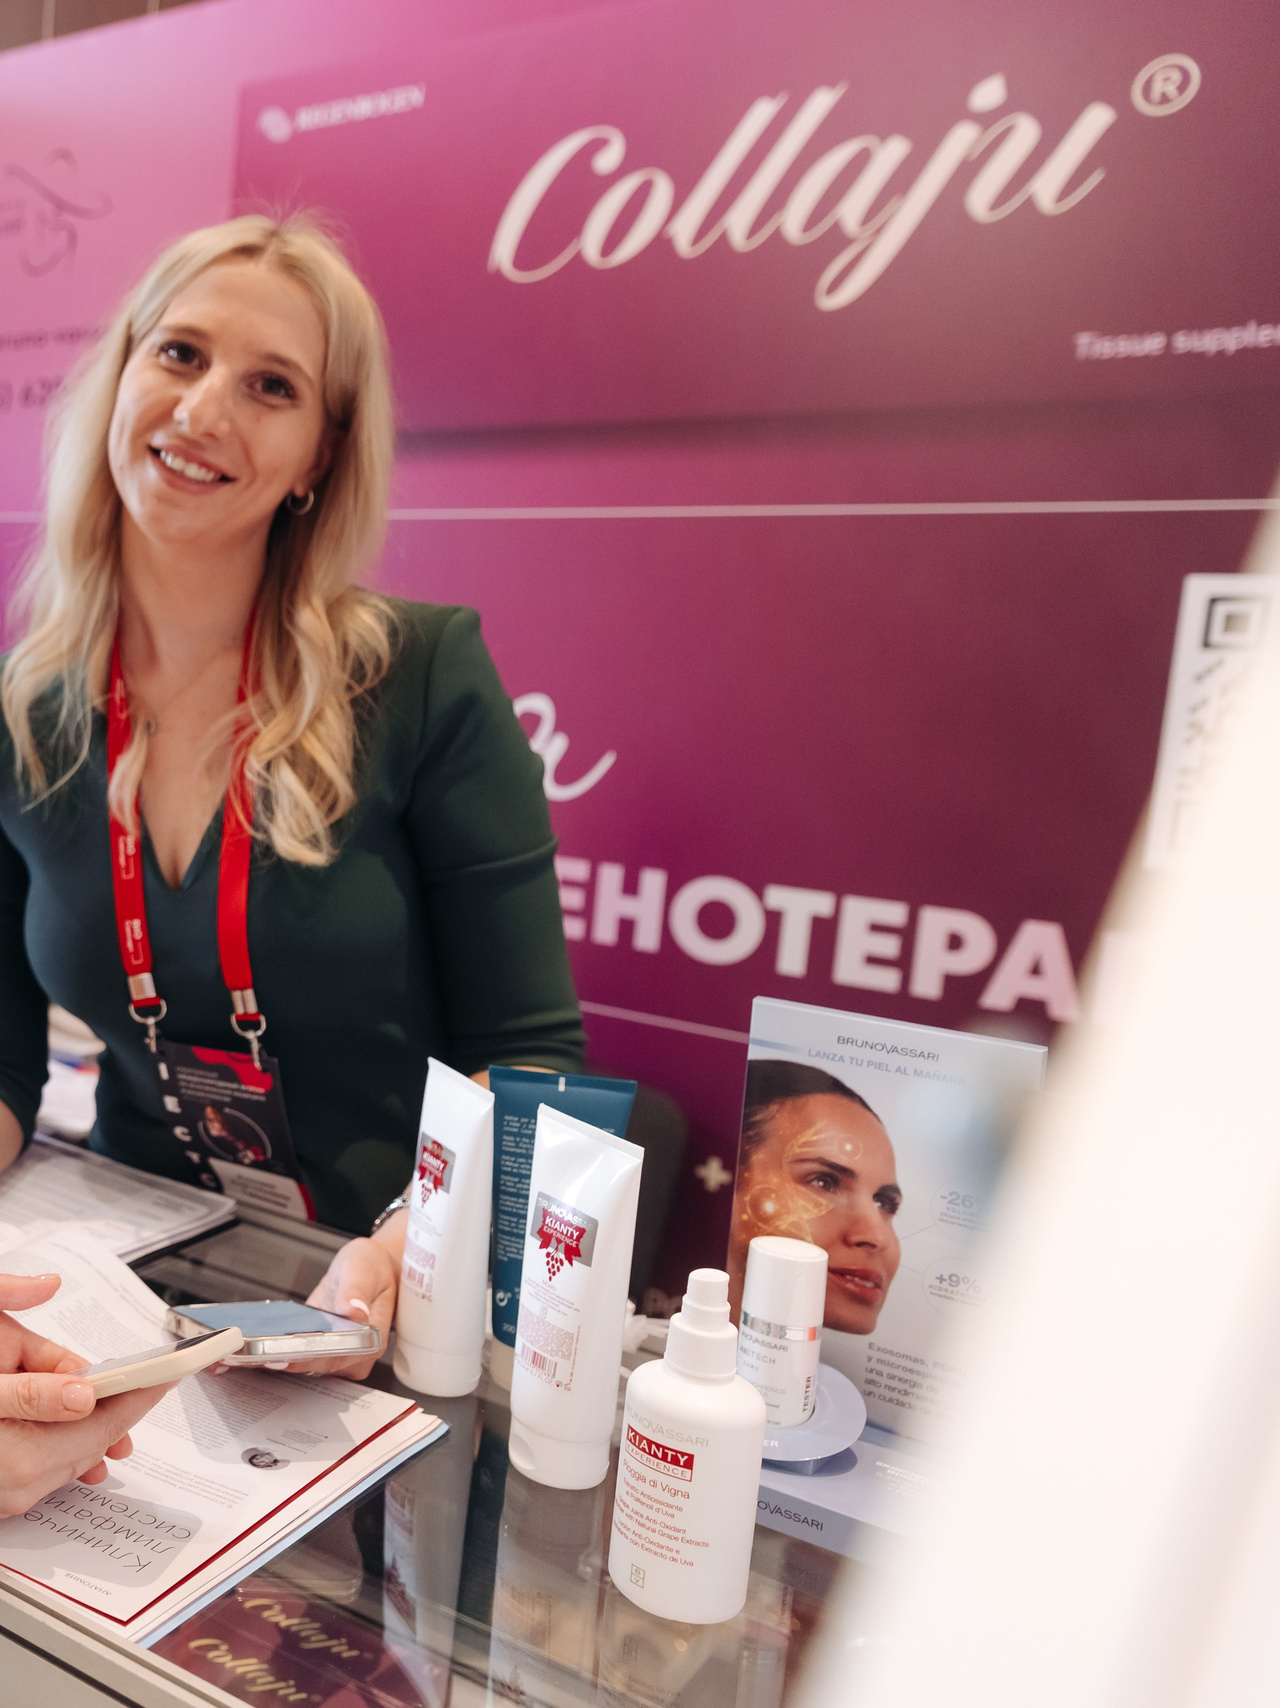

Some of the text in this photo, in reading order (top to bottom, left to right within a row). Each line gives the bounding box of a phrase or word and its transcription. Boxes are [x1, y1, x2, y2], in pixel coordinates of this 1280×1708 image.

[487, 72, 1118, 311] Collaju
[1075, 331, 1167, 360] Tissue
[554, 856, 1082, 1025] ЕНОТЕРА
[808, 1048, 845, 1064] LANZA
[849, 1056, 863, 1067] TU
[867, 1060, 892, 1073] PIEL
[895, 1066, 910, 1076] AL
[836, 1035, 940, 1062] BRUNOVASSARI
[543, 1225, 577, 1248] EXPERIENCE
[545, 1216, 579, 1240] KIANTY
[866, 1354, 873, 1363] y
[868, 1341, 929, 1368] Exosomas,
[864, 1377, 882, 1389] alto
[865, 1366, 884, 1377] una
[886, 1371, 924, 1389] sinergia
[803, 1376, 812, 1413] TESTER
[863, 1389, 876, 1399] un
[877, 1392, 918, 1411] cuidado
[627, 1443, 688, 1478] EXPERIENCE
[628, 1428, 689, 1466] KIANTY
[640, 1490, 684, 1512] Antiossidante
[649, 1479, 658, 1489] di
[660, 1482, 690, 1499] Vigna
[44, 1496, 175, 1555] лимфати
[69, 1484, 192, 1540] системы
[645, 1515, 687, 1535] Anti-Oxidant
[757, 1500, 824, 1531] OVASSARI
[24, 1510, 152, 1573] Клиниче
[632, 1529, 674, 1553] Anti-Oxidante
[635, 1518, 657, 1534] Natural
[657, 1529, 680, 1542] Grape
[681, 1536, 710, 1548] Extracts
[641, 1543, 668, 1560] Extracto
[669, 1555, 678, 1564] de
[680, 1558, 694, 1567] Uva
[65, 1572, 113, 1596] АНАТОМИЯ
